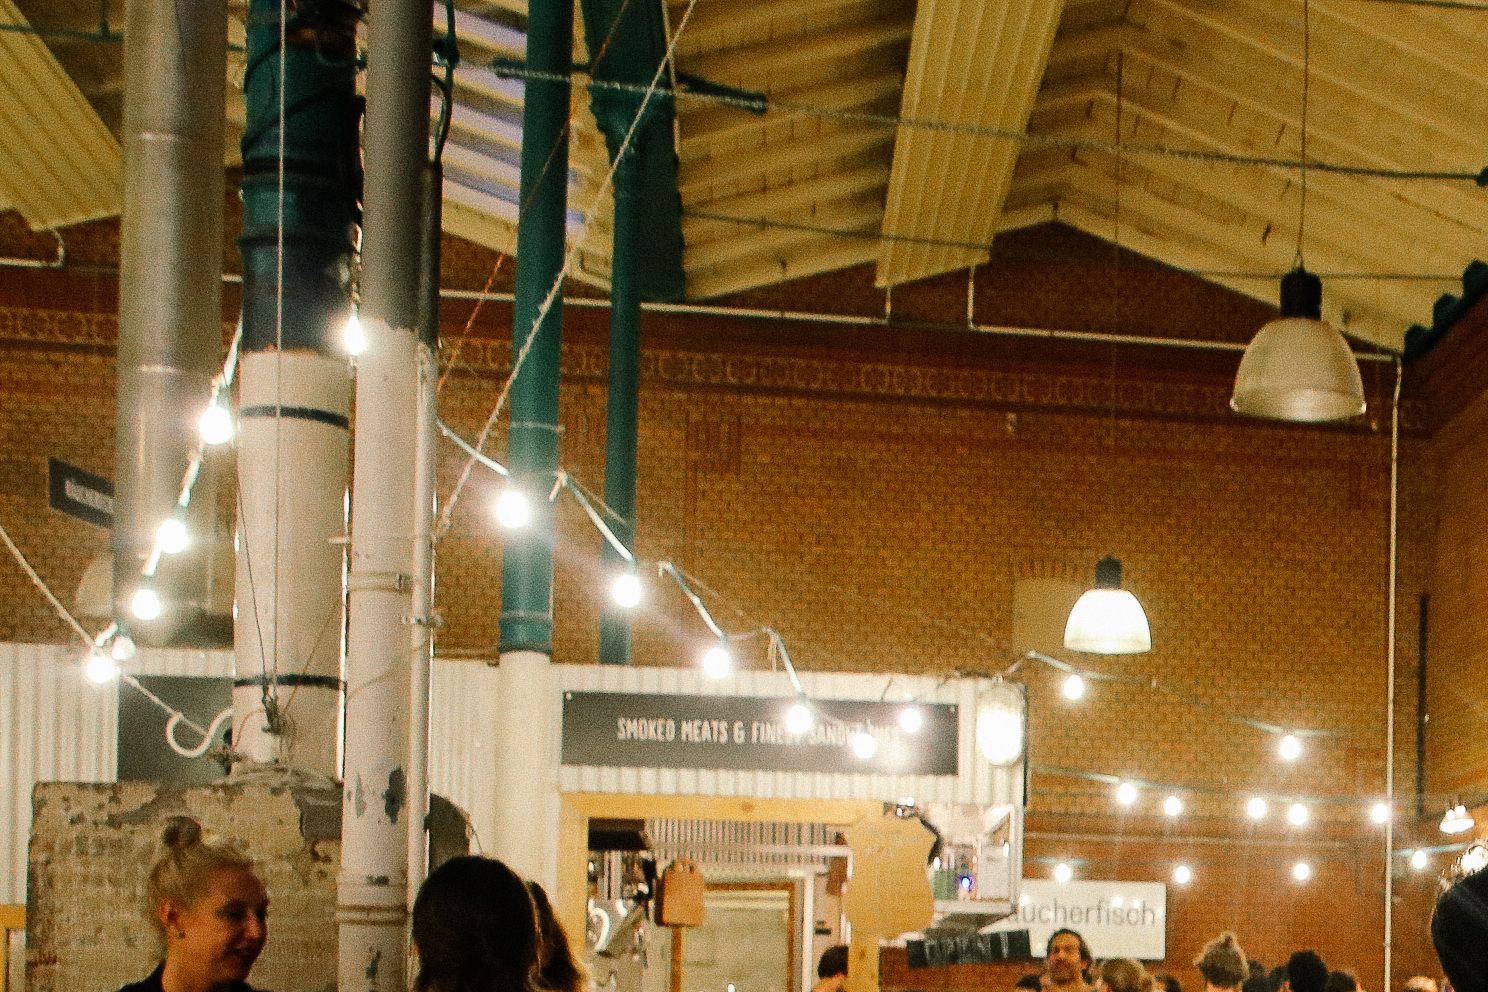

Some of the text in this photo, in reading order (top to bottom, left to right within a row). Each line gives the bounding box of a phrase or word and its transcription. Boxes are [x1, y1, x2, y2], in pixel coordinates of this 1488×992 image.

[617, 717, 676, 743] SMOKED
[680, 718, 728, 744] MEATS
[751, 719, 803, 746] FINE
